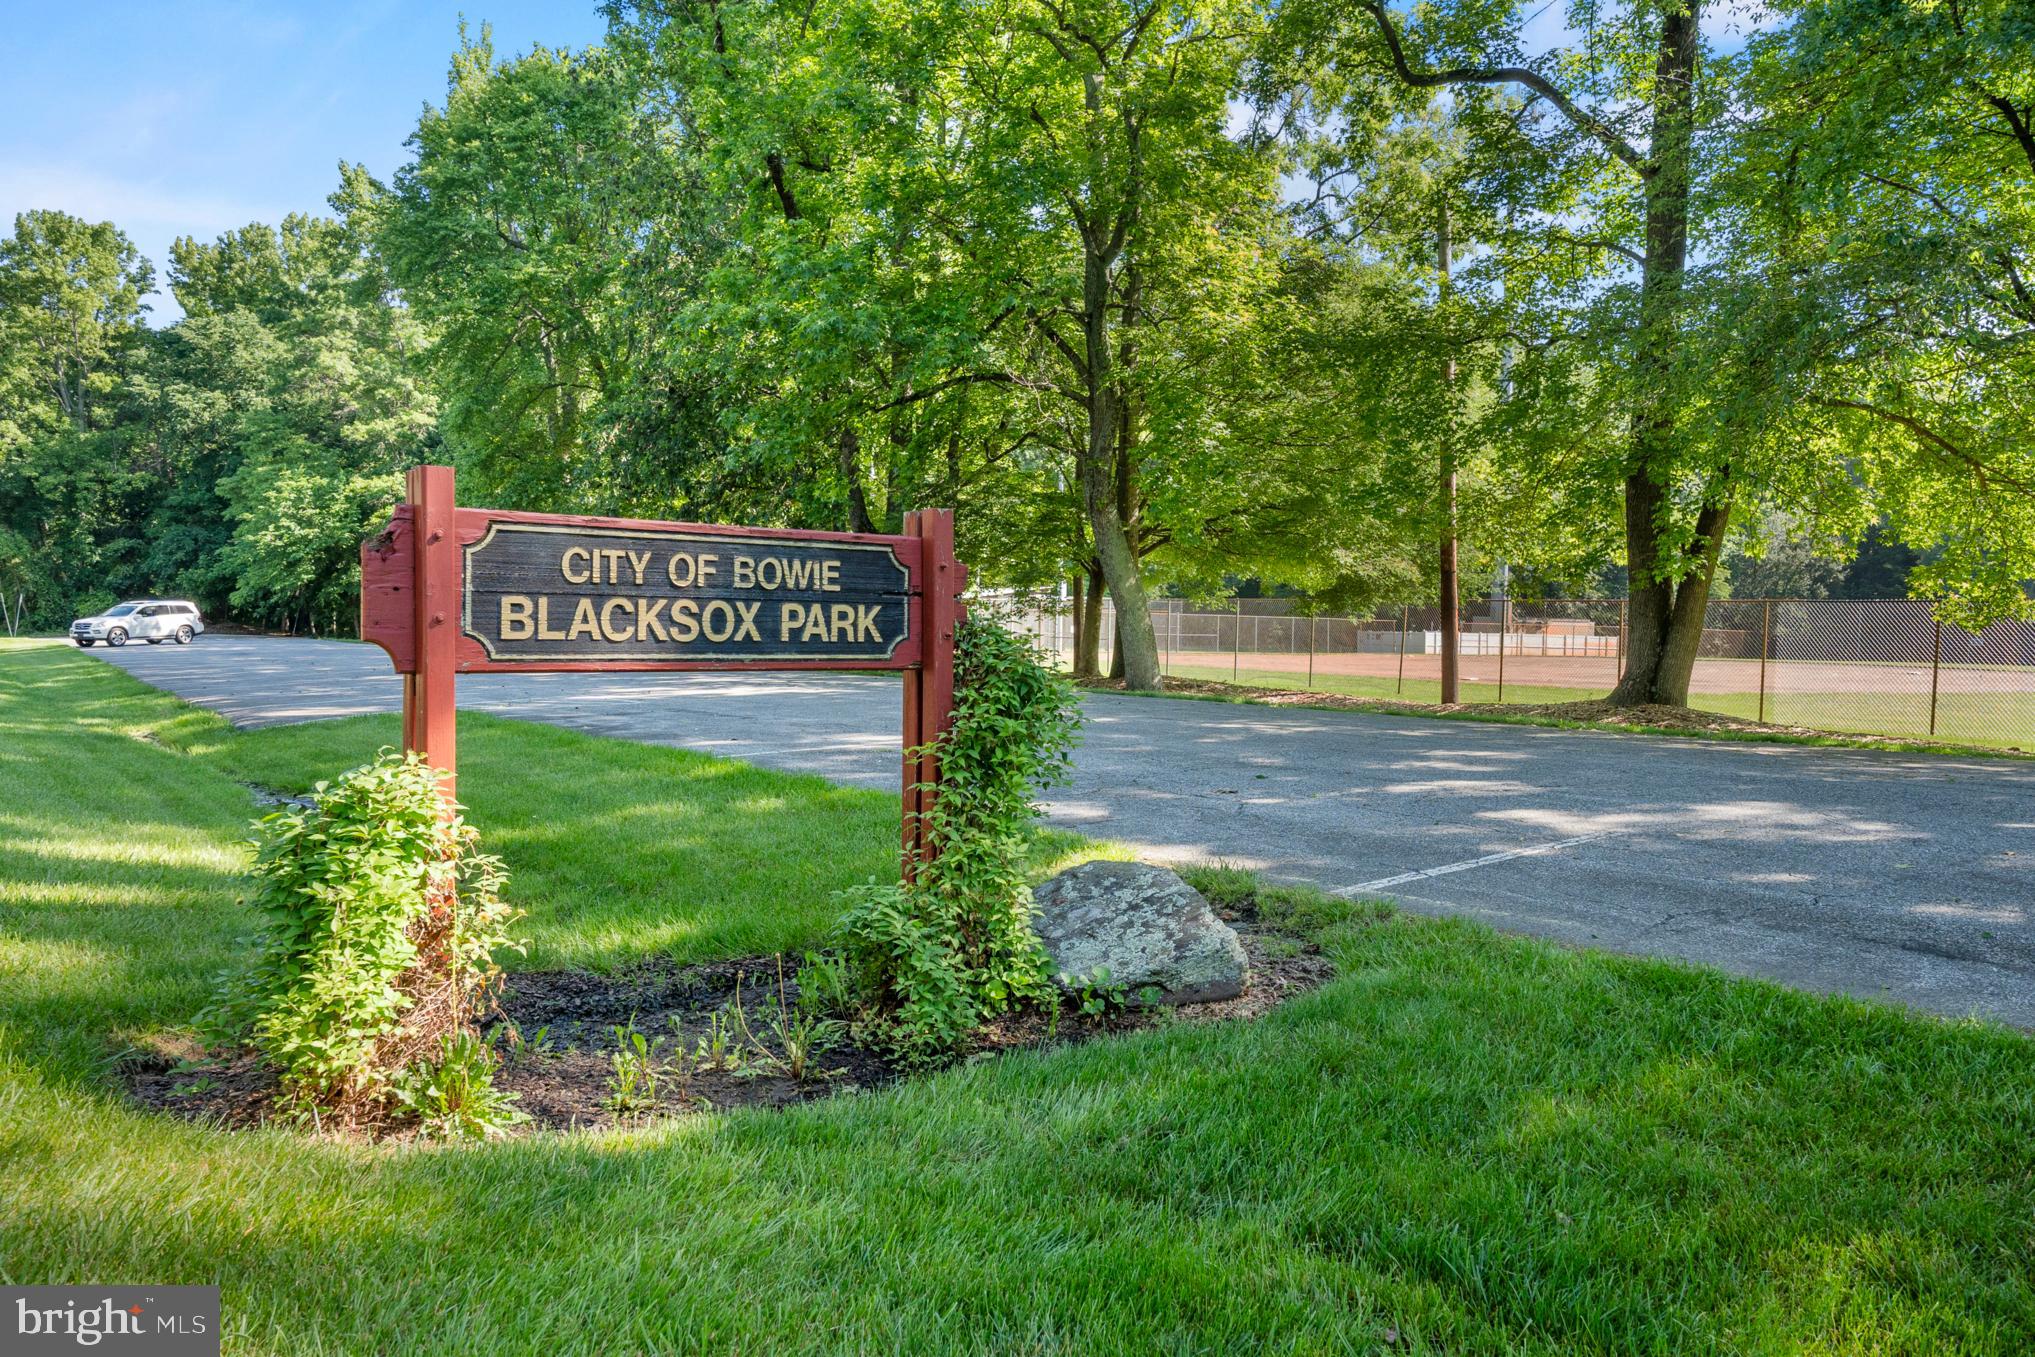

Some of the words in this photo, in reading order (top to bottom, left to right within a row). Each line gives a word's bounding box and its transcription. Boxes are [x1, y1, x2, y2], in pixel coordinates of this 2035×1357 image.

[561, 546, 651, 585] CITY
[667, 551, 717, 587] OF
[733, 555, 841, 591] BOWIE
[500, 595, 761, 642] BLACKSOX
[780, 603, 883, 643] PARK
